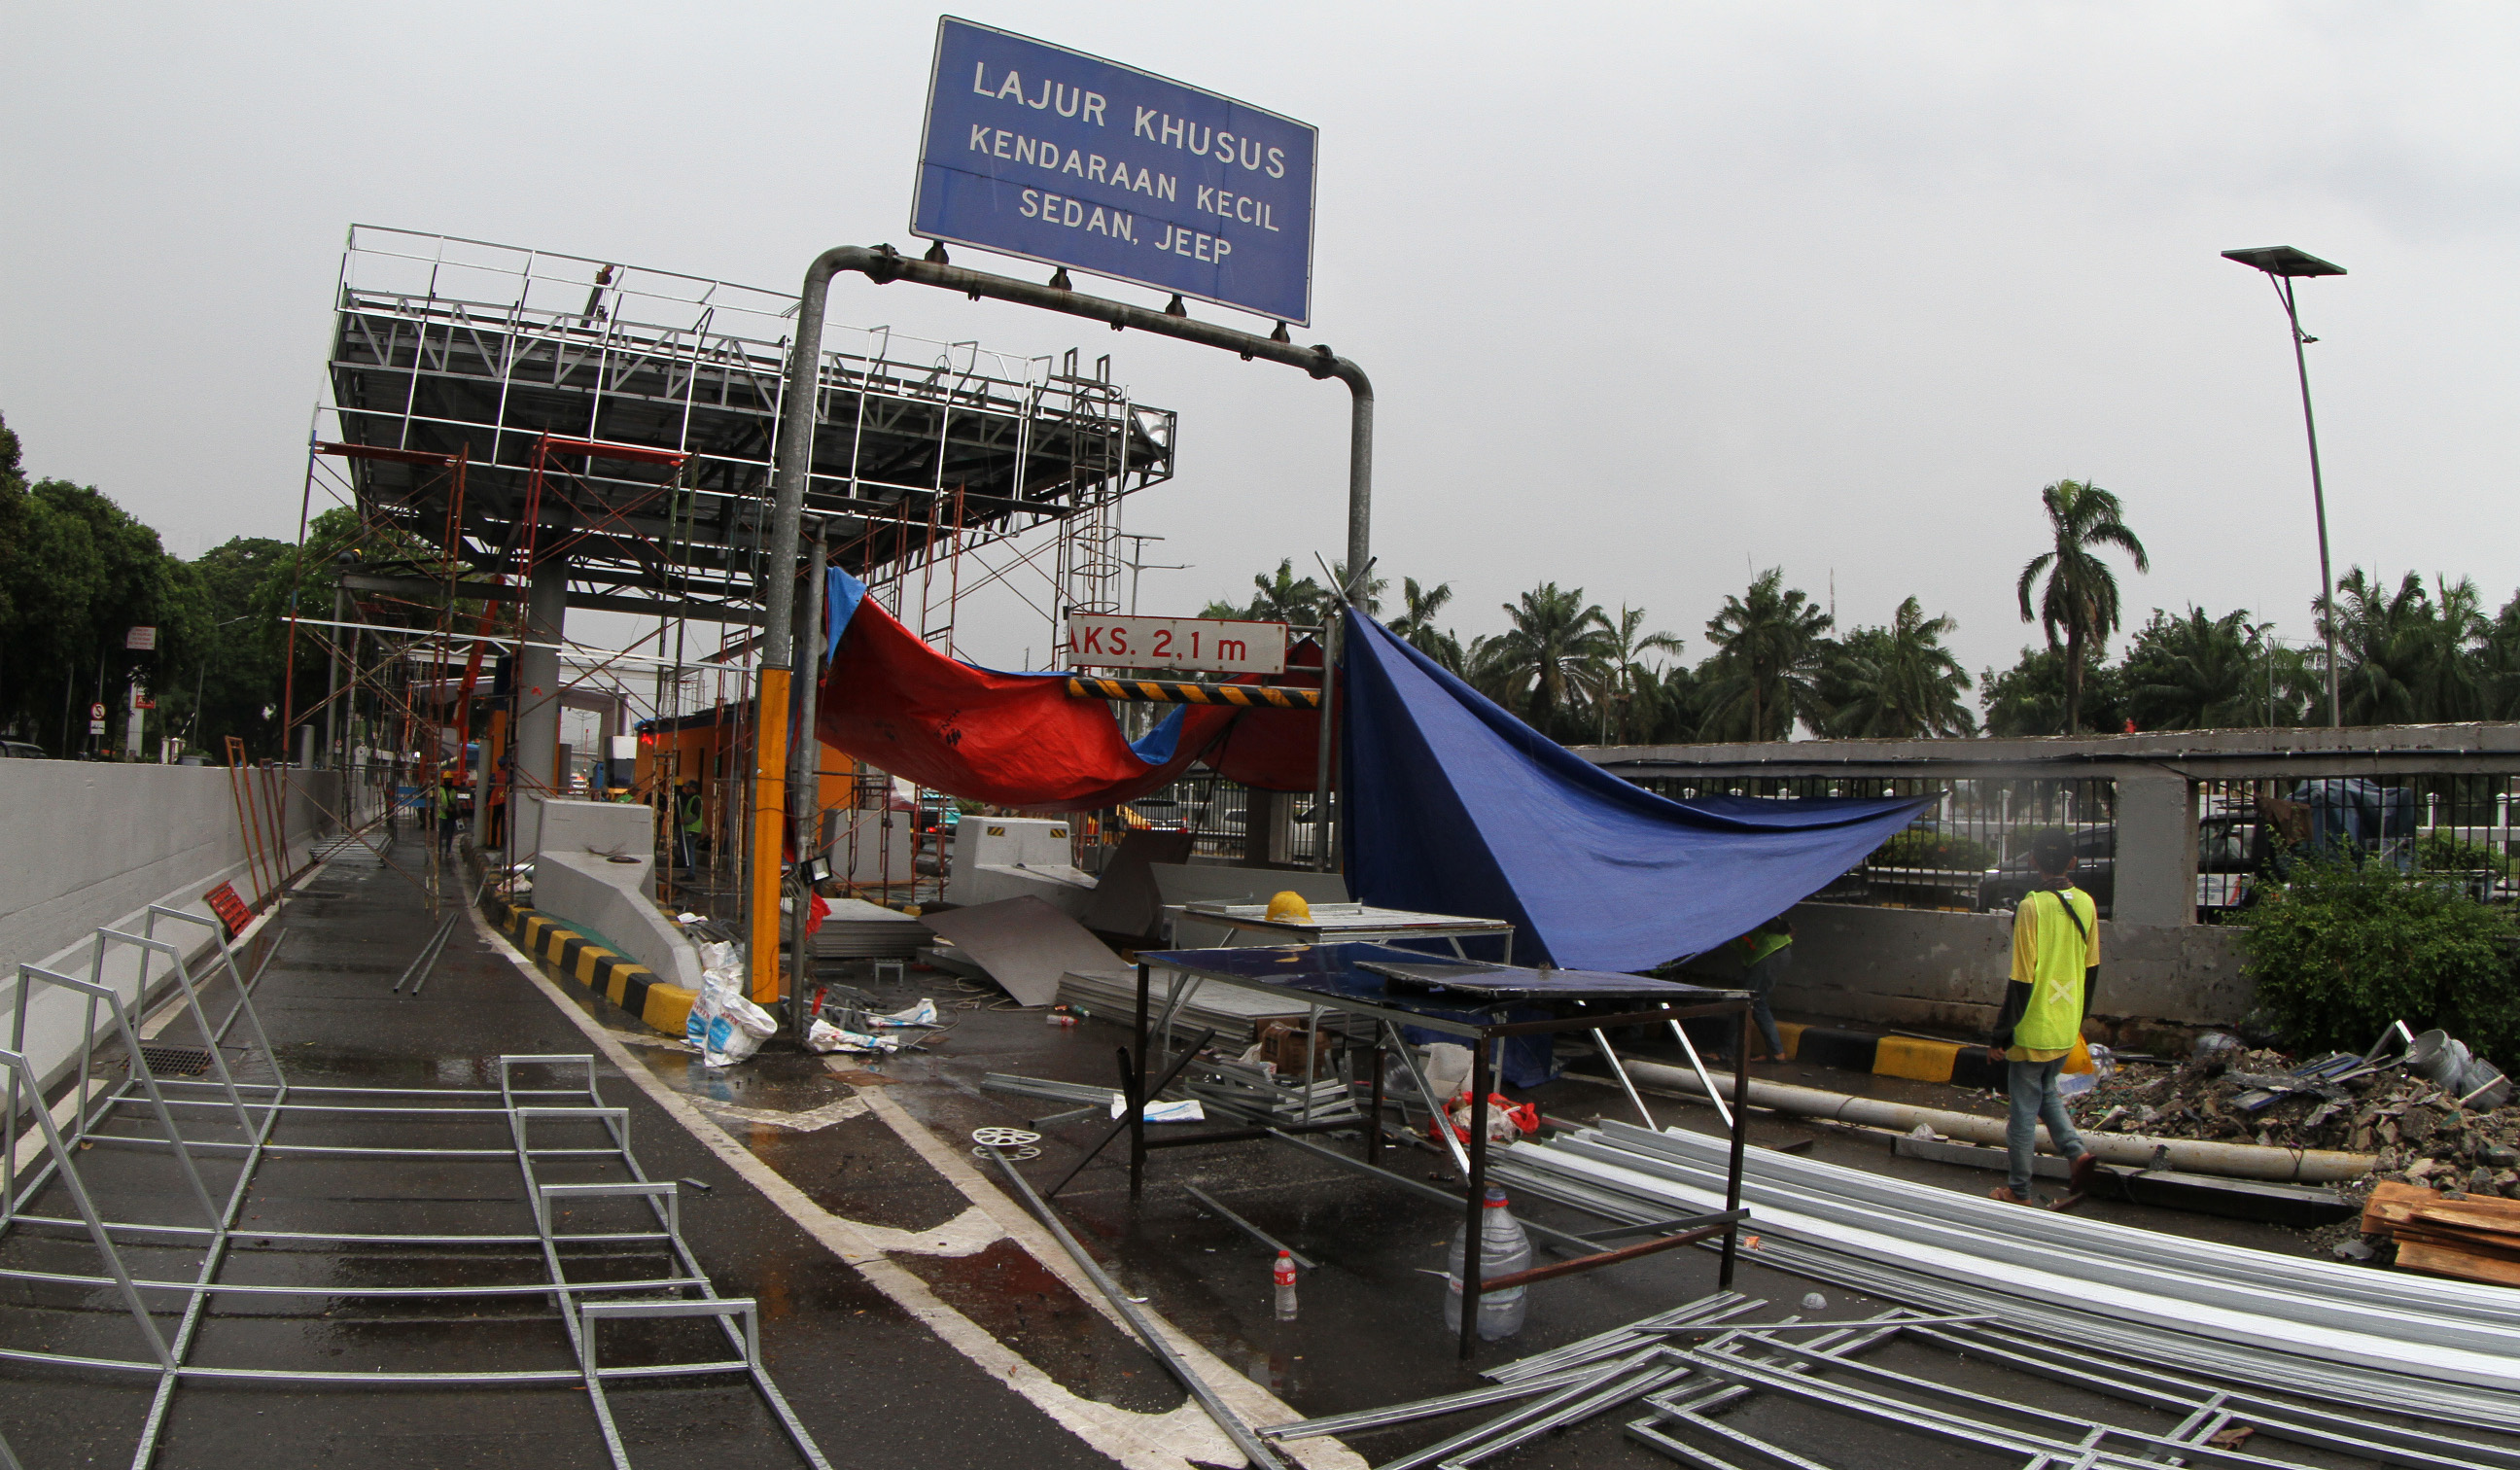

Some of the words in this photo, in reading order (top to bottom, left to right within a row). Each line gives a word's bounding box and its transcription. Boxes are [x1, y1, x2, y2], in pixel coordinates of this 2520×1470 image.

[972, 60, 1107, 127] LAJUR
[1134, 105, 1285, 179] KHUSUS
[969, 123, 1177, 202] KENDARAAN
[1196, 184, 1280, 232] KECIL
[1018, 189, 1138, 246] SEDAN,
[1153, 225, 1232, 264] JEEP
[1152, 630, 1200, 661] 2,1
[1217, 639, 1246, 661] m
